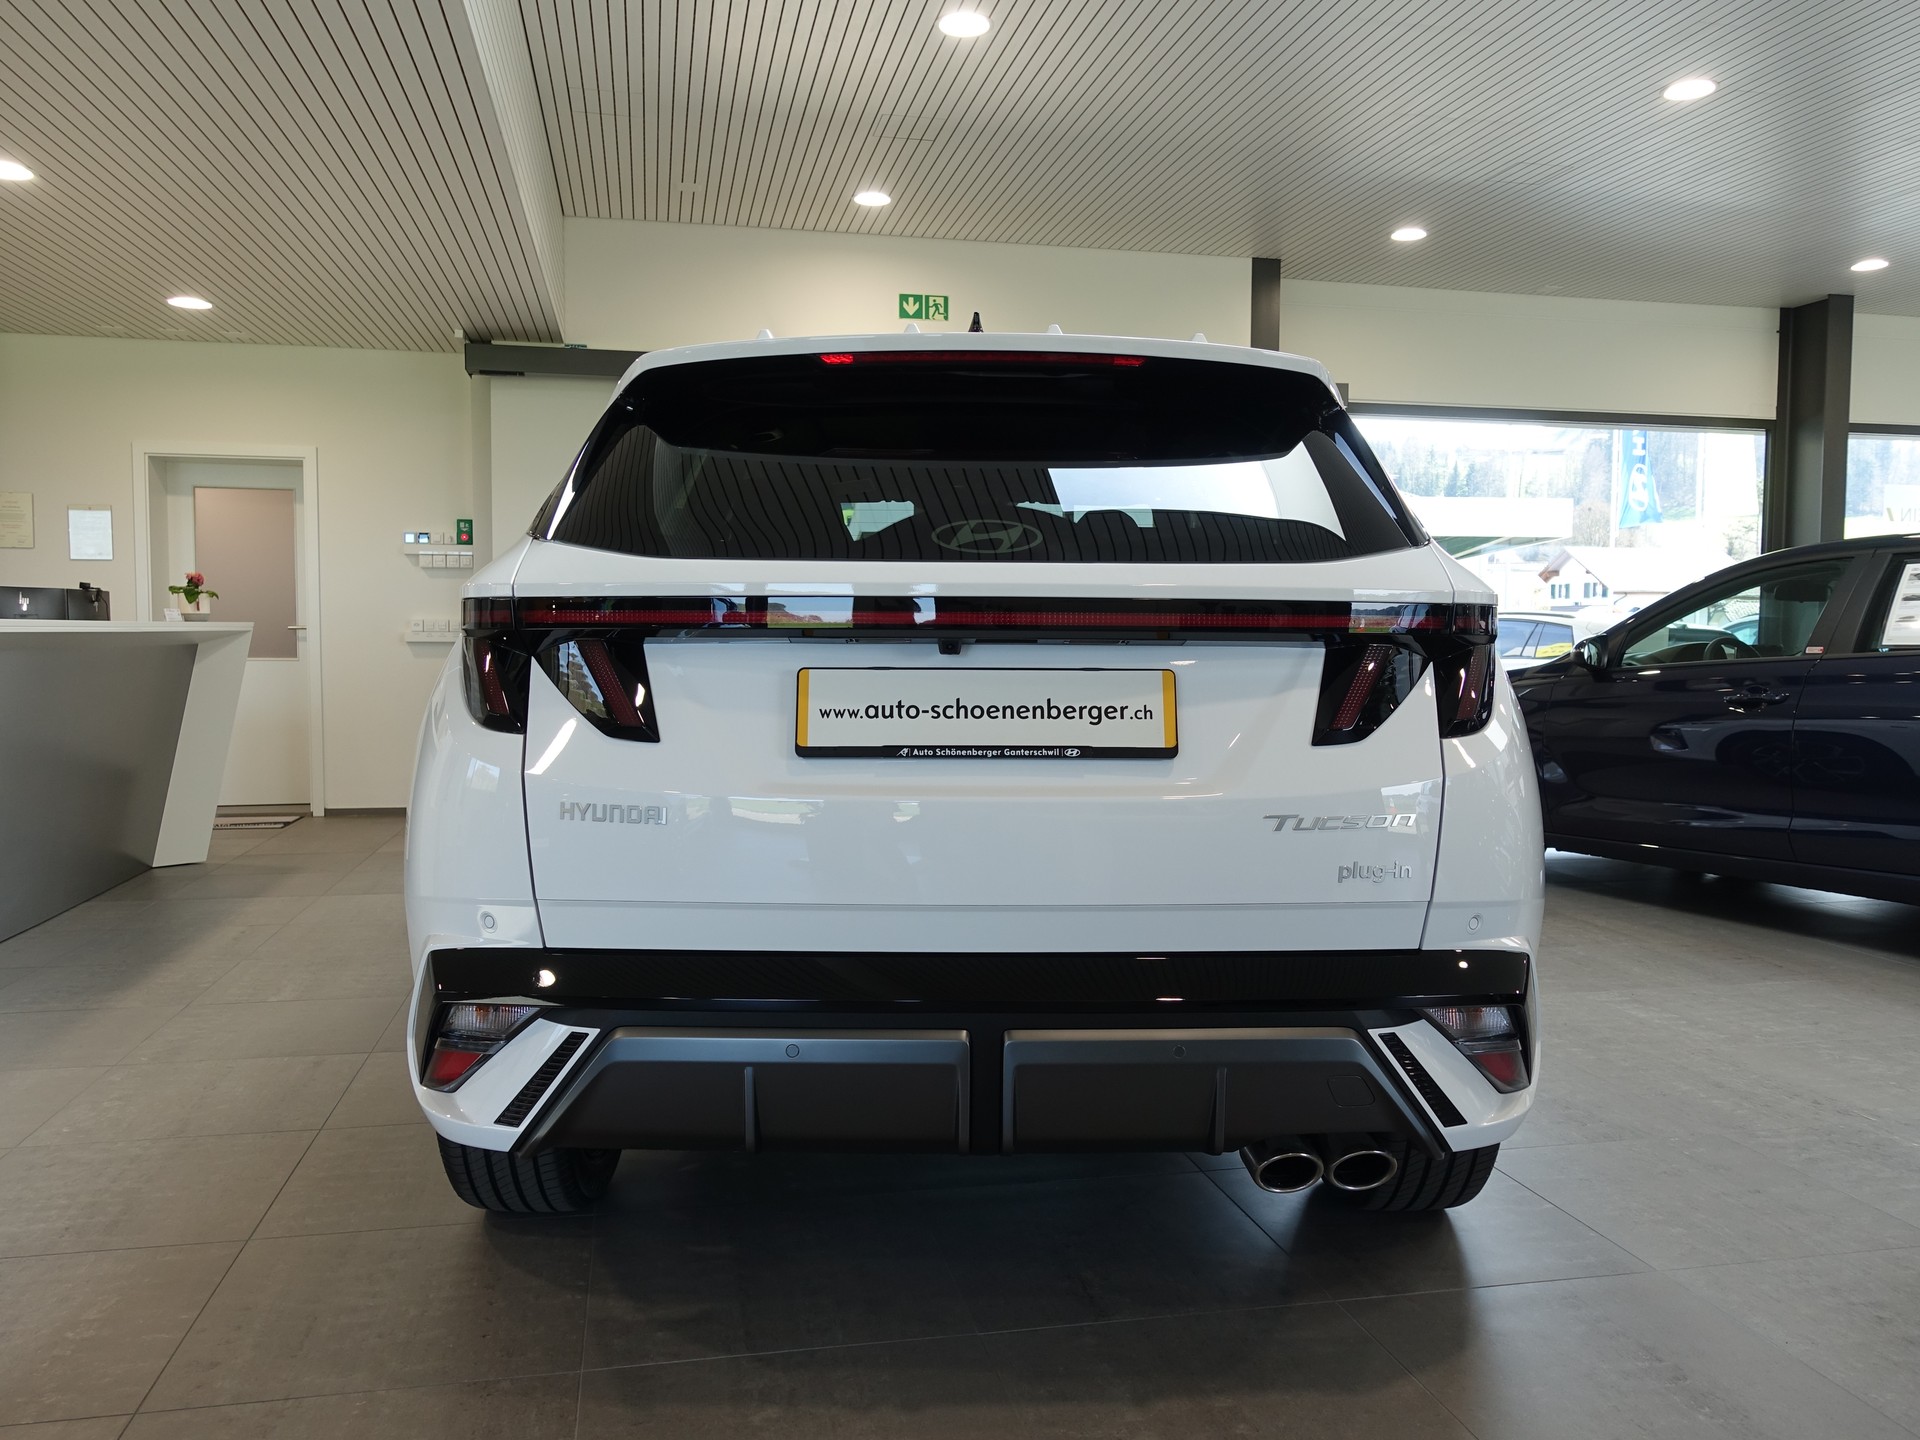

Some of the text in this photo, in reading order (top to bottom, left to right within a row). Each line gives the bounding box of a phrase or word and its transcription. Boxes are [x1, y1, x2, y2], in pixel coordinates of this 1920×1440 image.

[819, 697, 1153, 726] www.auto-schoenenberger.ch
[912, 748, 934, 756] Auto
[935, 747, 1001, 758] Schönenberger
[1003, 748, 1060, 757] Ganterschwil
[559, 801, 668, 825] HYUNDAI
[1337, 860, 1413, 884] plug-in
